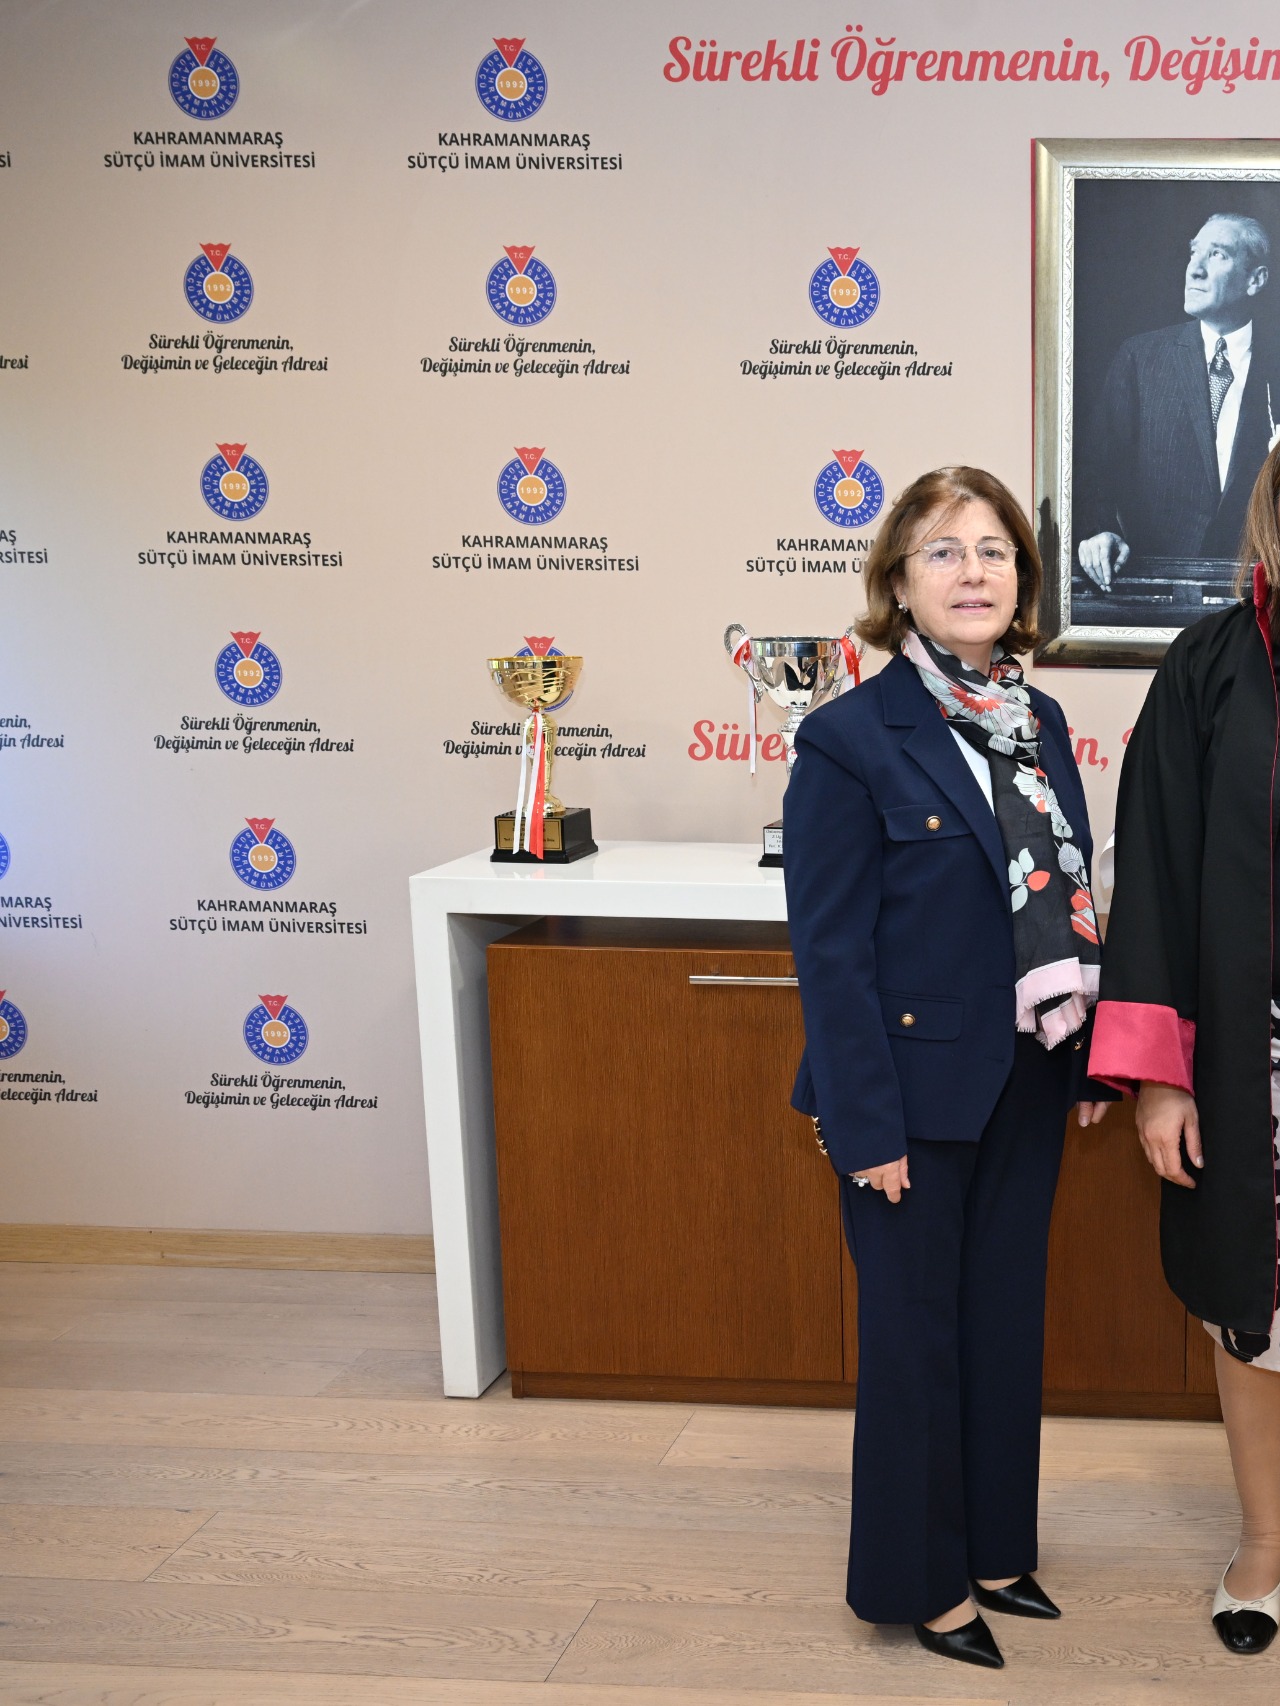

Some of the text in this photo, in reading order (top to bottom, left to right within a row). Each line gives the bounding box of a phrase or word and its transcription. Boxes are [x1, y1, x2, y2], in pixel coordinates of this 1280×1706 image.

[663, 36, 820, 82] Sürekli
[831, 25, 1109, 96] Öğrenmenin,
[193, 79, 217, 88] 1992
[500, 80, 525, 89] 1992
[134, 132, 283, 149] KAHRAMANMARAŞ
[439, 133, 590, 151] KAHRAMANMARAŞ
[104, 151, 315, 171] SÜTÇÜ İMAM ÜNİVERSİTESİ
[408, 152, 622, 173] SÜTÇÜ İMAM ÜNİVERSİTESİ
[208, 284, 232, 293] 1992
[510, 286, 534, 295] 1992
[149, 331, 293, 354] Sürekli Öğrenmenin,
[449, 334, 595, 357] Sürekli Öğrenmenin,
[769, 336, 917, 359] Sürekli Öğrenmenin,
[121, 355, 328, 375] Değişimin ve Geleceğin Adresi
[420, 357, 630, 378] Değişimin ve Geleceğin Adresi
[740, 360, 953, 380] Değişimin ve Geleceğin Adresi
[167, 531, 311, 548] KAHRAMANMARAŞ
[462, 535, 608, 553] KAHRAMANMARAŞ
[777, 539, 868, 552] KAHRAMAN
[138, 549, 342, 568] SÜTÇÜ İMAM ÜNİVERSİTESİ
[432, 553, 639, 572] SÜTÇÜ İMAM ÜNİVERSİTESİ
[747, 557, 796, 576] SÜTÇÜ
[802, 557, 846, 573] İMAM
[180, 713, 320, 735] Sürekli Öğrenmenin,
[471, 721, 521, 736] Sürekli
[20, 734, 64, 749] Adresi
[154, 735, 354, 755] Değişimin ve Geleceğin Adresi
[443, 740, 512, 759] Değişimin
[554, 742, 597, 760] eceğin
[600, 743, 646, 759] Adresi
[197, 900, 337, 917] KAHRAMANMARAŞ
[0, 914, 82, 928] NİVERSİTESİ
[170, 916, 367, 934] SÜTÇÜ İMAM ÜNİVERSİTESİ
[0, 1071, 65, 1084] renmenin,
[210, 1071, 345, 1092] Sürekli Öğrenmenin,
[0, 1088, 98, 1105] eleceğin Adresi
[185, 1091, 378, 1111] Değişimin ve Geleceğin Adresi
